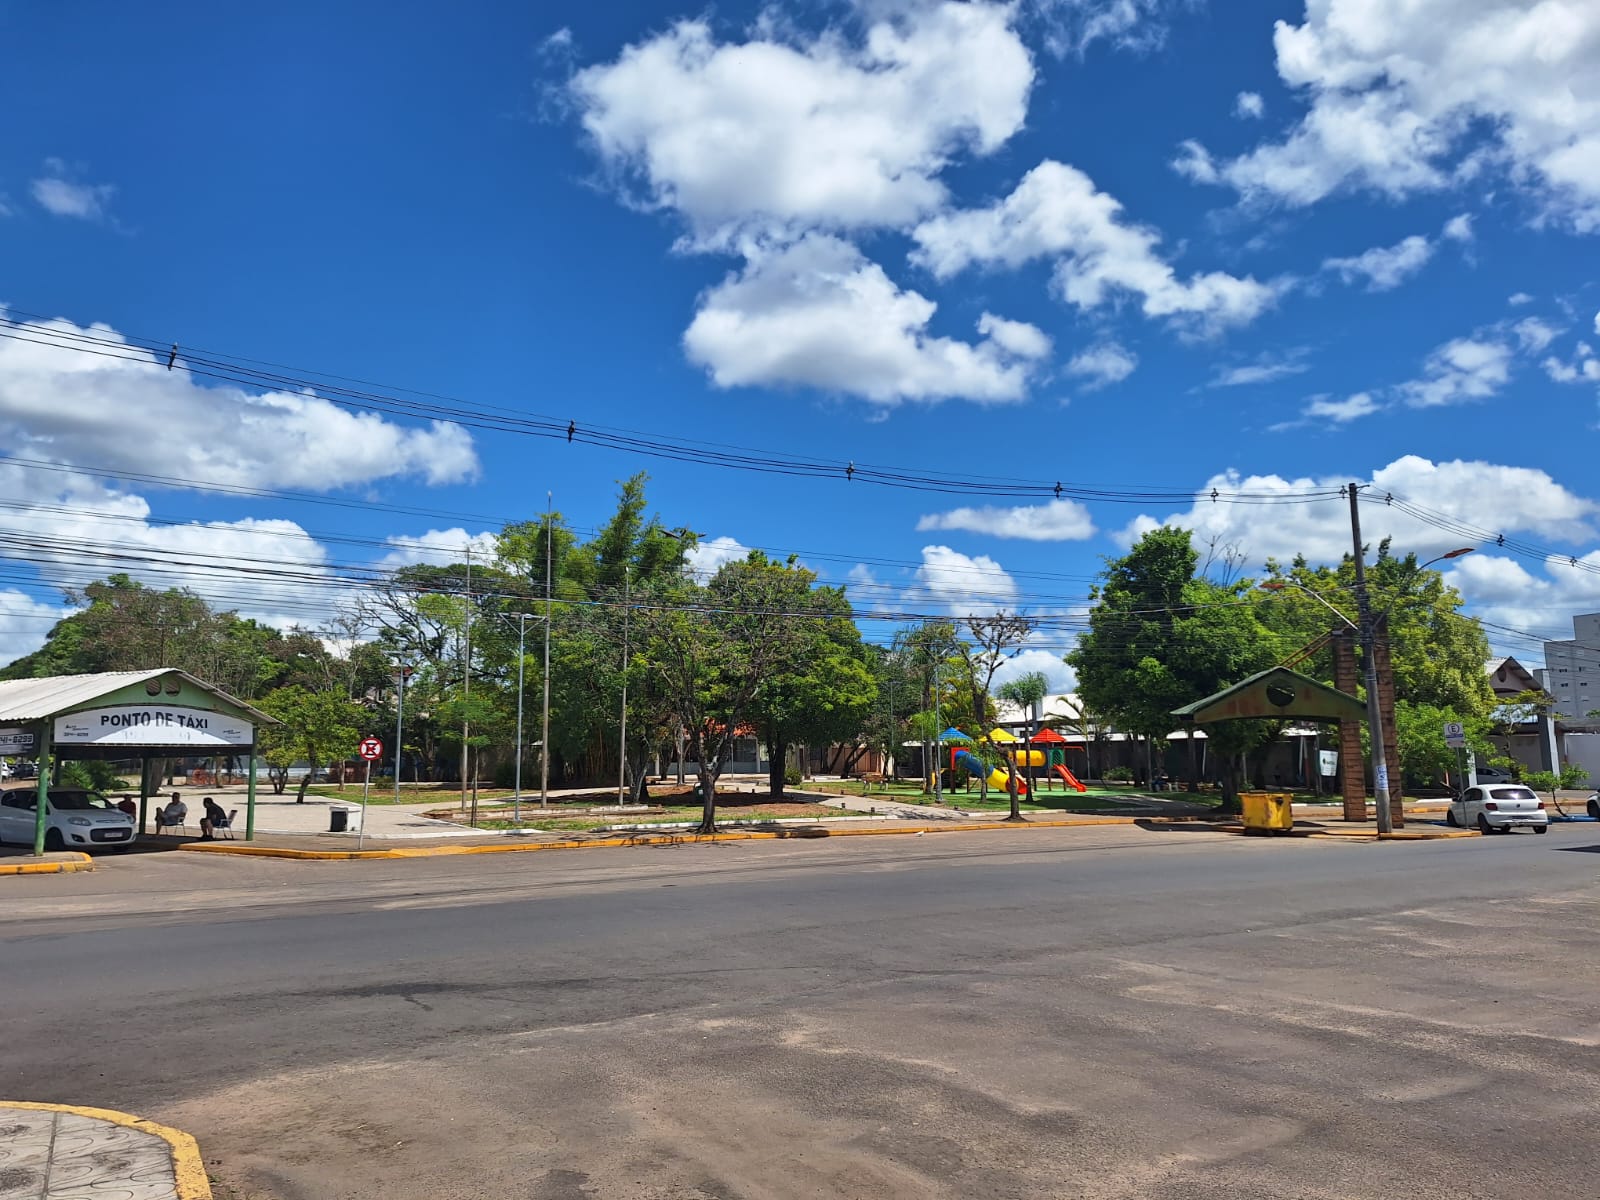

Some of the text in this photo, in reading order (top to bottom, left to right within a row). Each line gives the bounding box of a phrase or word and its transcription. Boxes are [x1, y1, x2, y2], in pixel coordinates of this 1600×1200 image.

[101, 711, 150, 727] PONTO
[155, 711, 174, 727] DE
[178, 714, 208, 729] TÁXI
